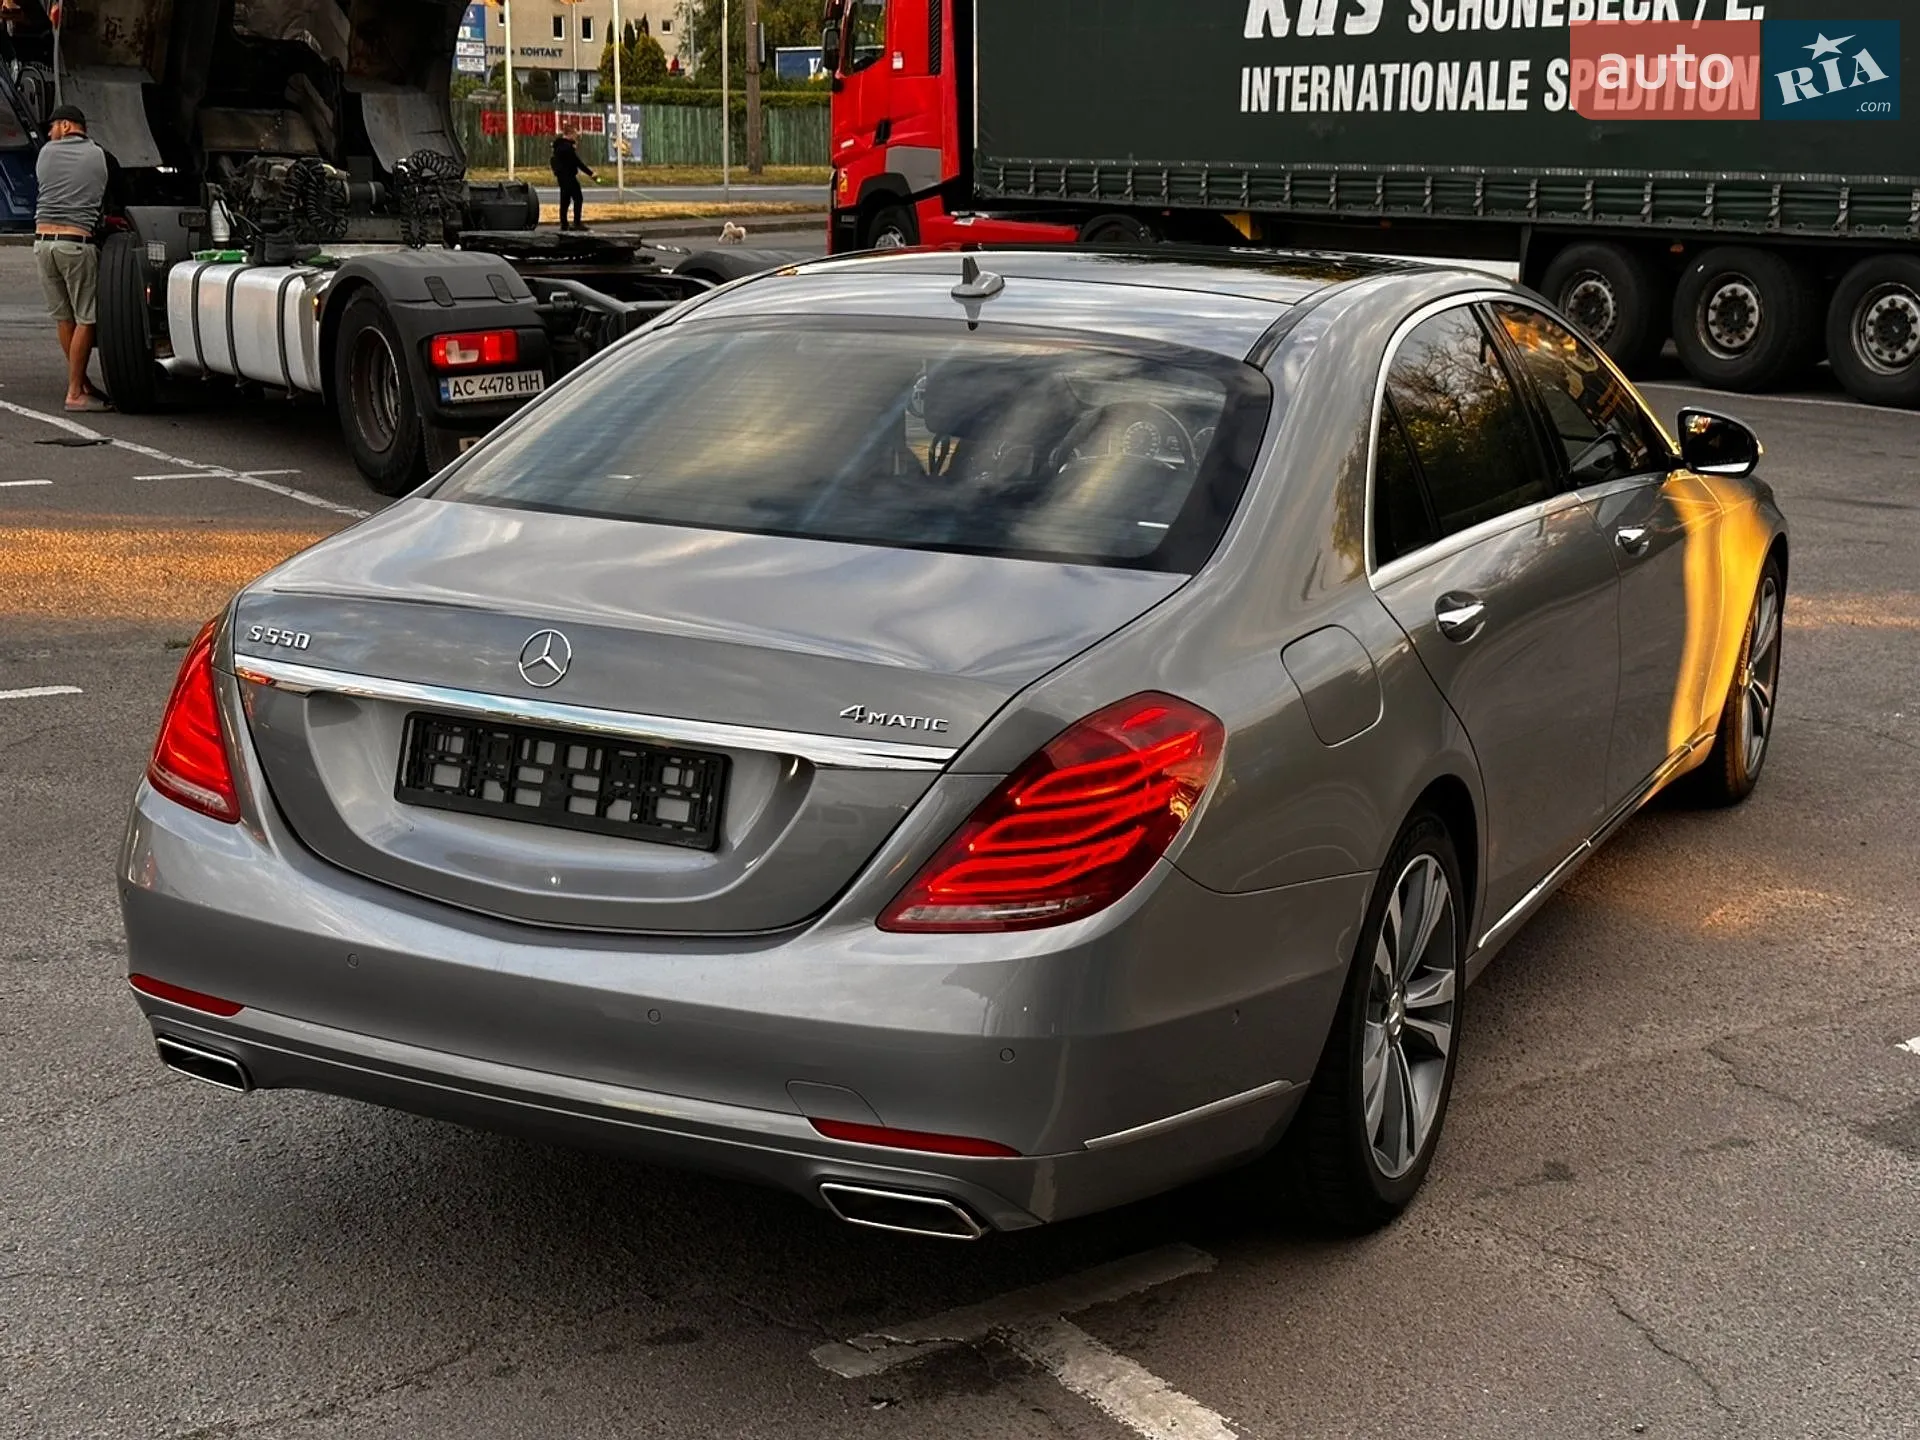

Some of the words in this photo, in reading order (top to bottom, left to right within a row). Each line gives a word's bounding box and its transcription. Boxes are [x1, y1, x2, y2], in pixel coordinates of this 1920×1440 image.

[519, 46, 563, 58] КОНТАКТ
[1240, 60, 1530, 112] INTERNATIONALE
[1543, 55, 1761, 112] SPEDITION
[452, 379, 475, 397] AC
[478, 375, 515, 395] 4478
[517, 373, 540, 391] HH
[248, 625, 264, 641] S
[264, 627, 311, 650] 550
[840, 704, 950, 732] 4MATIC
